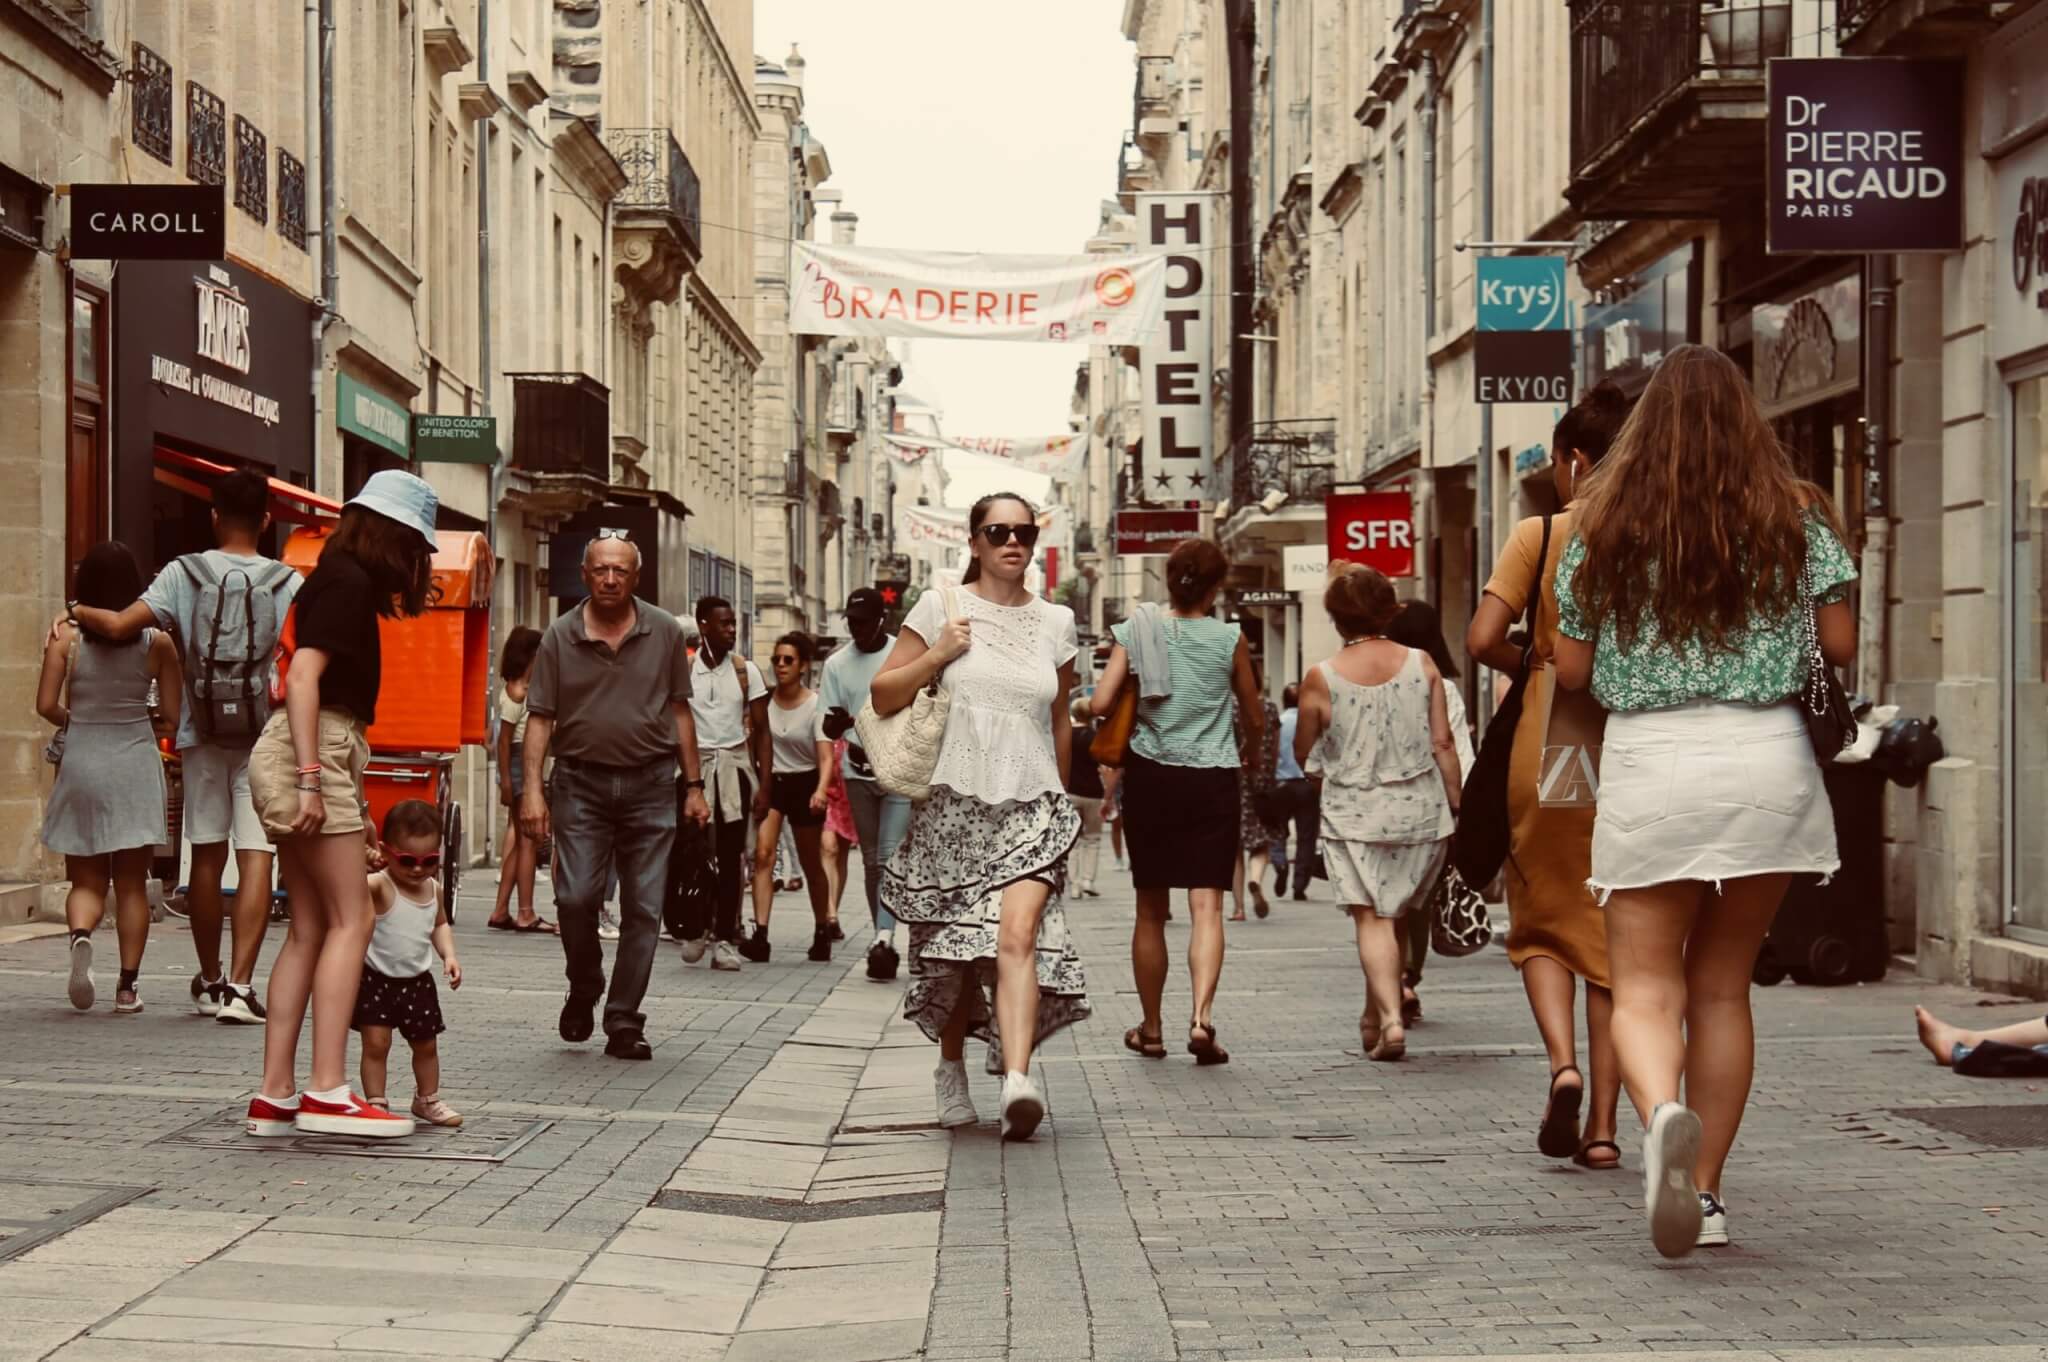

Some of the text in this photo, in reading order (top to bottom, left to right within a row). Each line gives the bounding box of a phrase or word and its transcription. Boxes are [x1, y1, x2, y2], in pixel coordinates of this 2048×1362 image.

[1786, 96, 1825, 126] Dr
[1786, 131, 1922, 162] PIERRE
[1786, 167, 1946, 200] RICAUD
[89, 212, 204, 233] CAROLL
[1786, 203, 1854, 217] PARIS
[822, 280, 1038, 325] BRADERIE
[1481, 279, 1552, 314] Krys
[1149, 203, 1201, 458] HOTEL
[1479, 376, 1566, 400] EKYOG
[418, 418, 489, 428] UNITED COLORS
[418, 428, 431, 437] OF
[1346, 520, 1411, 550] SFR
[1242, 591, 1291, 602] AGATHA
[1539, 744, 1602, 801] ZA
